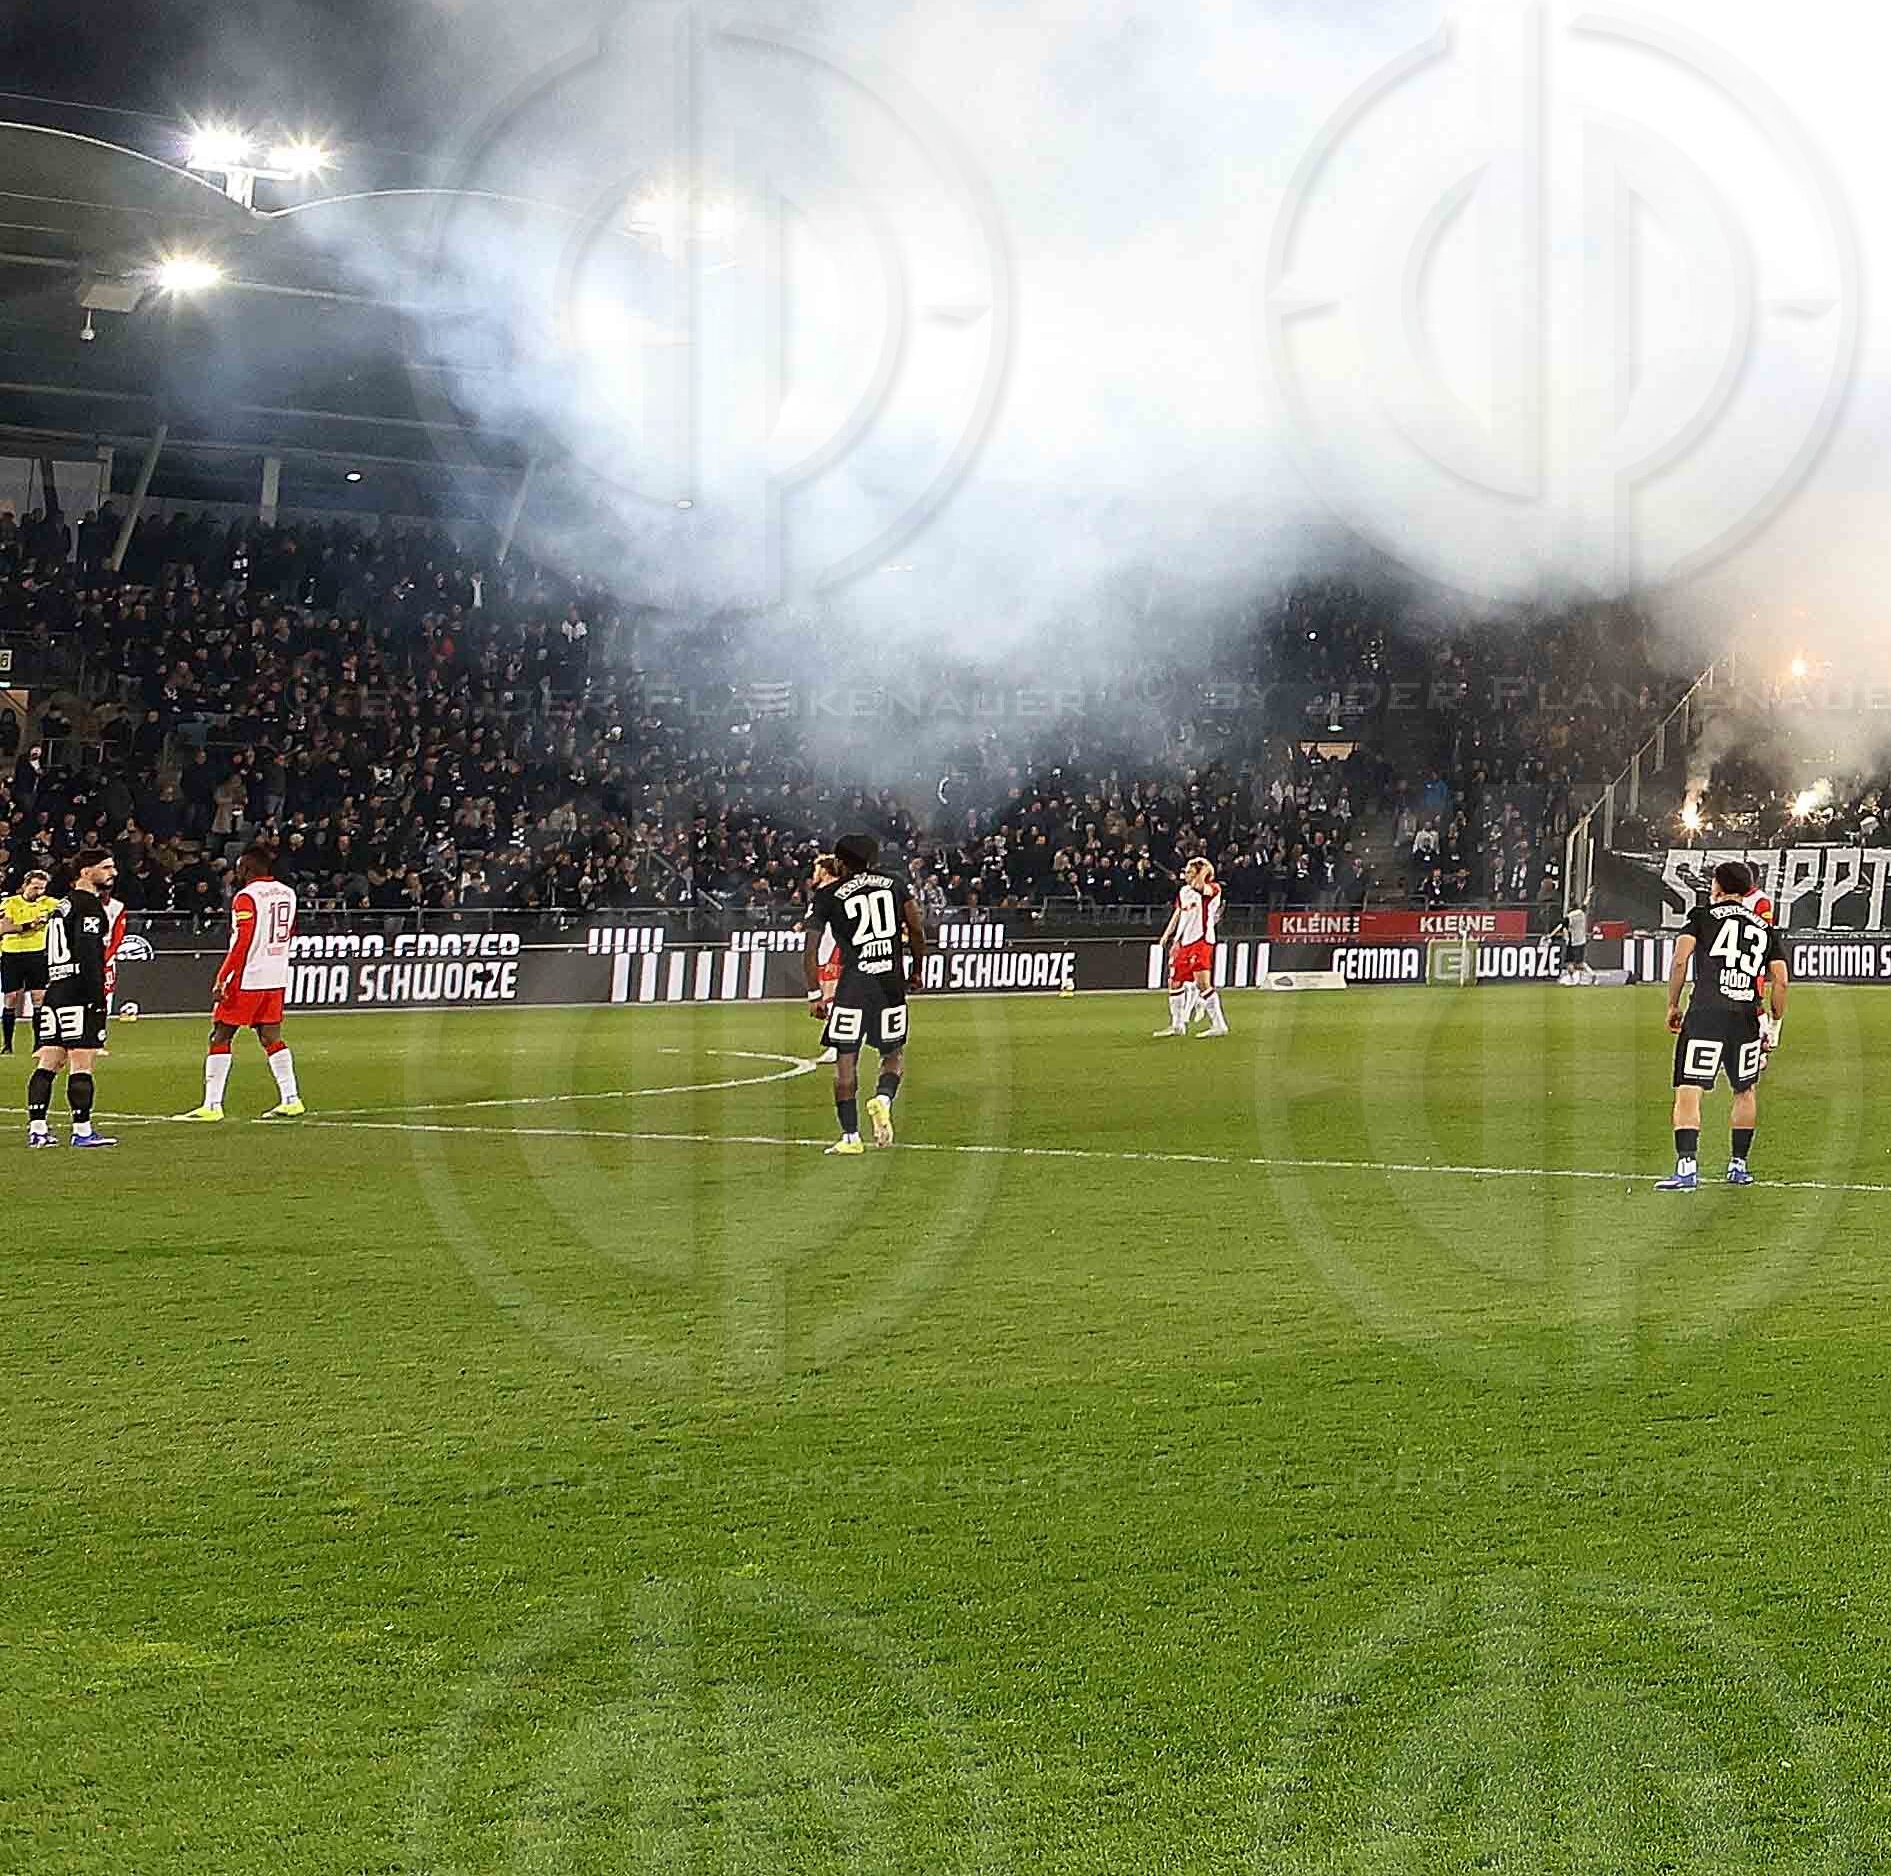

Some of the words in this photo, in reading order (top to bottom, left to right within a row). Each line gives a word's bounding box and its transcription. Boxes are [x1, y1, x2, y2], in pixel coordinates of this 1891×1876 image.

[269, 901, 291, 943] 19
[844, 889, 897, 946] 20
[1332, 948, 1419, 980] GEMMA
[1709, 918, 1768, 977] 43
[1793, 944, 1876, 979] GEMMA
[950, 952, 1075, 989] SCHWOAZE
